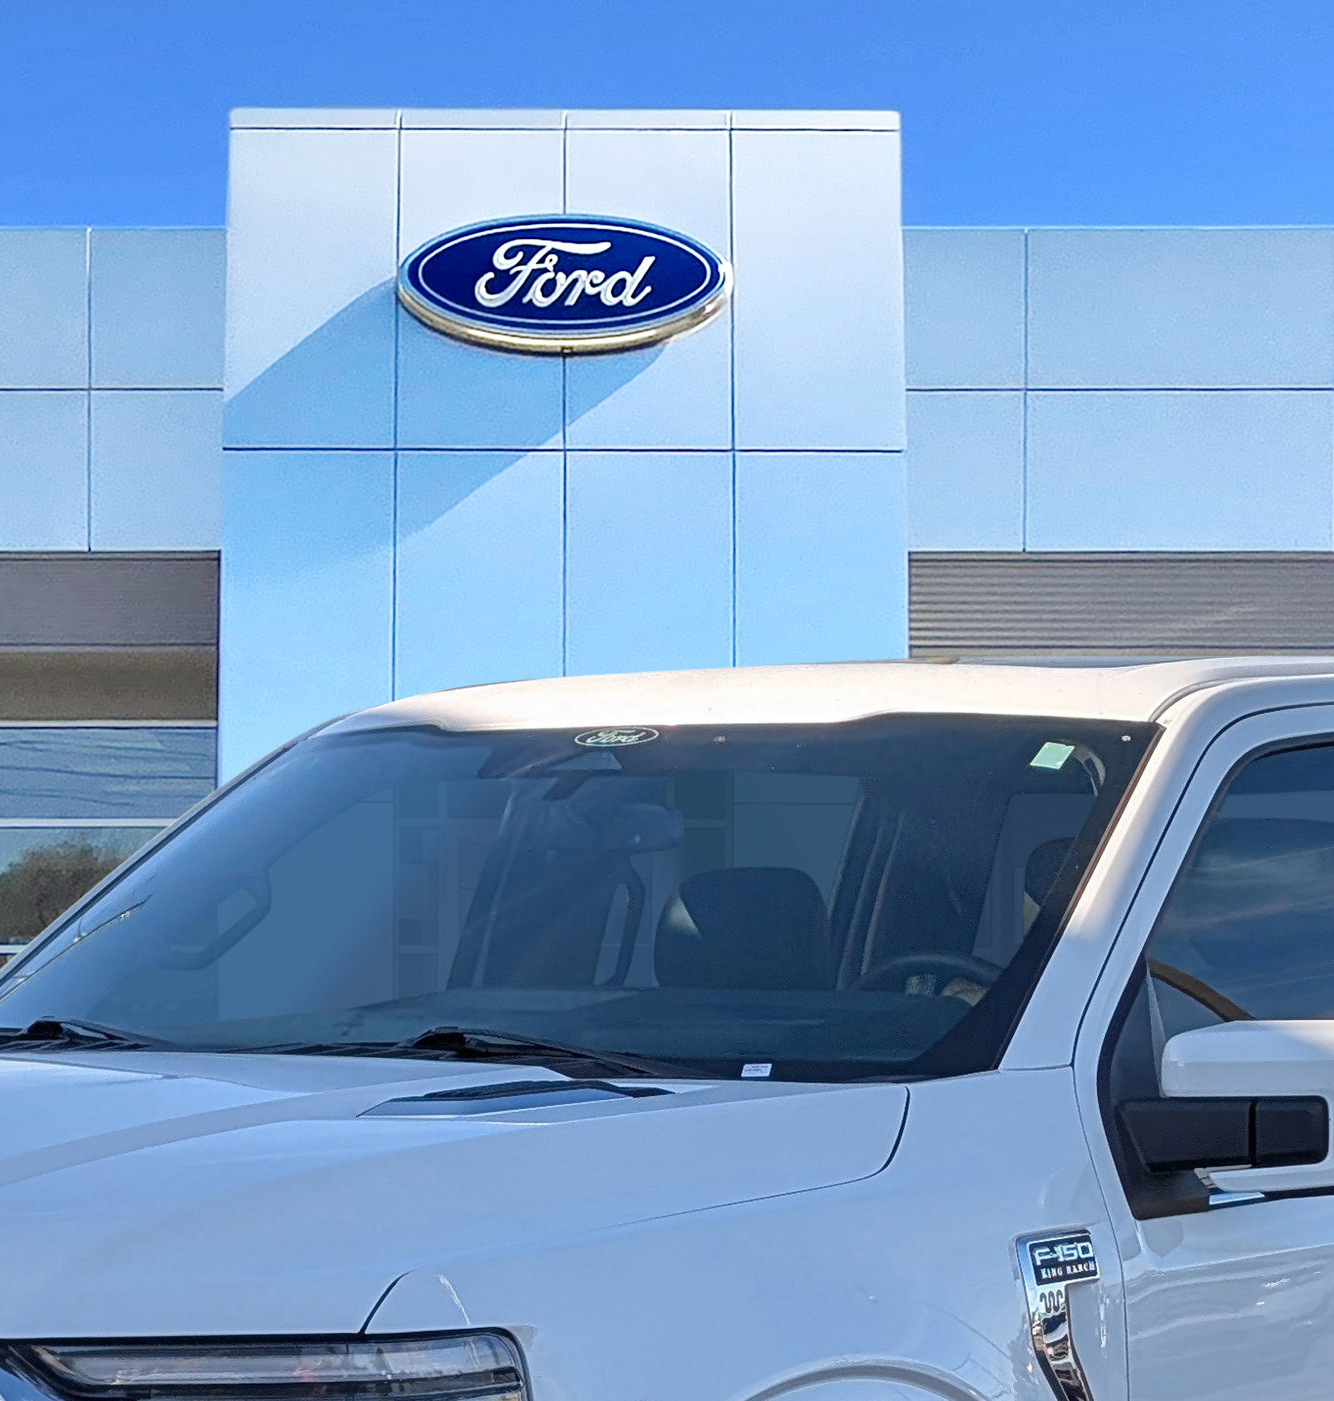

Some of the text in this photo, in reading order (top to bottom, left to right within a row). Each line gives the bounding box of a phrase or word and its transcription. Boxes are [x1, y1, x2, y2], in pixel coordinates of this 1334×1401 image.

[474, 237, 654, 308] Ford
[585, 729, 647, 745] Ford
[1033, 1241, 1094, 1266] F-150
[1040, 1260, 1096, 1280] KING RANCH
